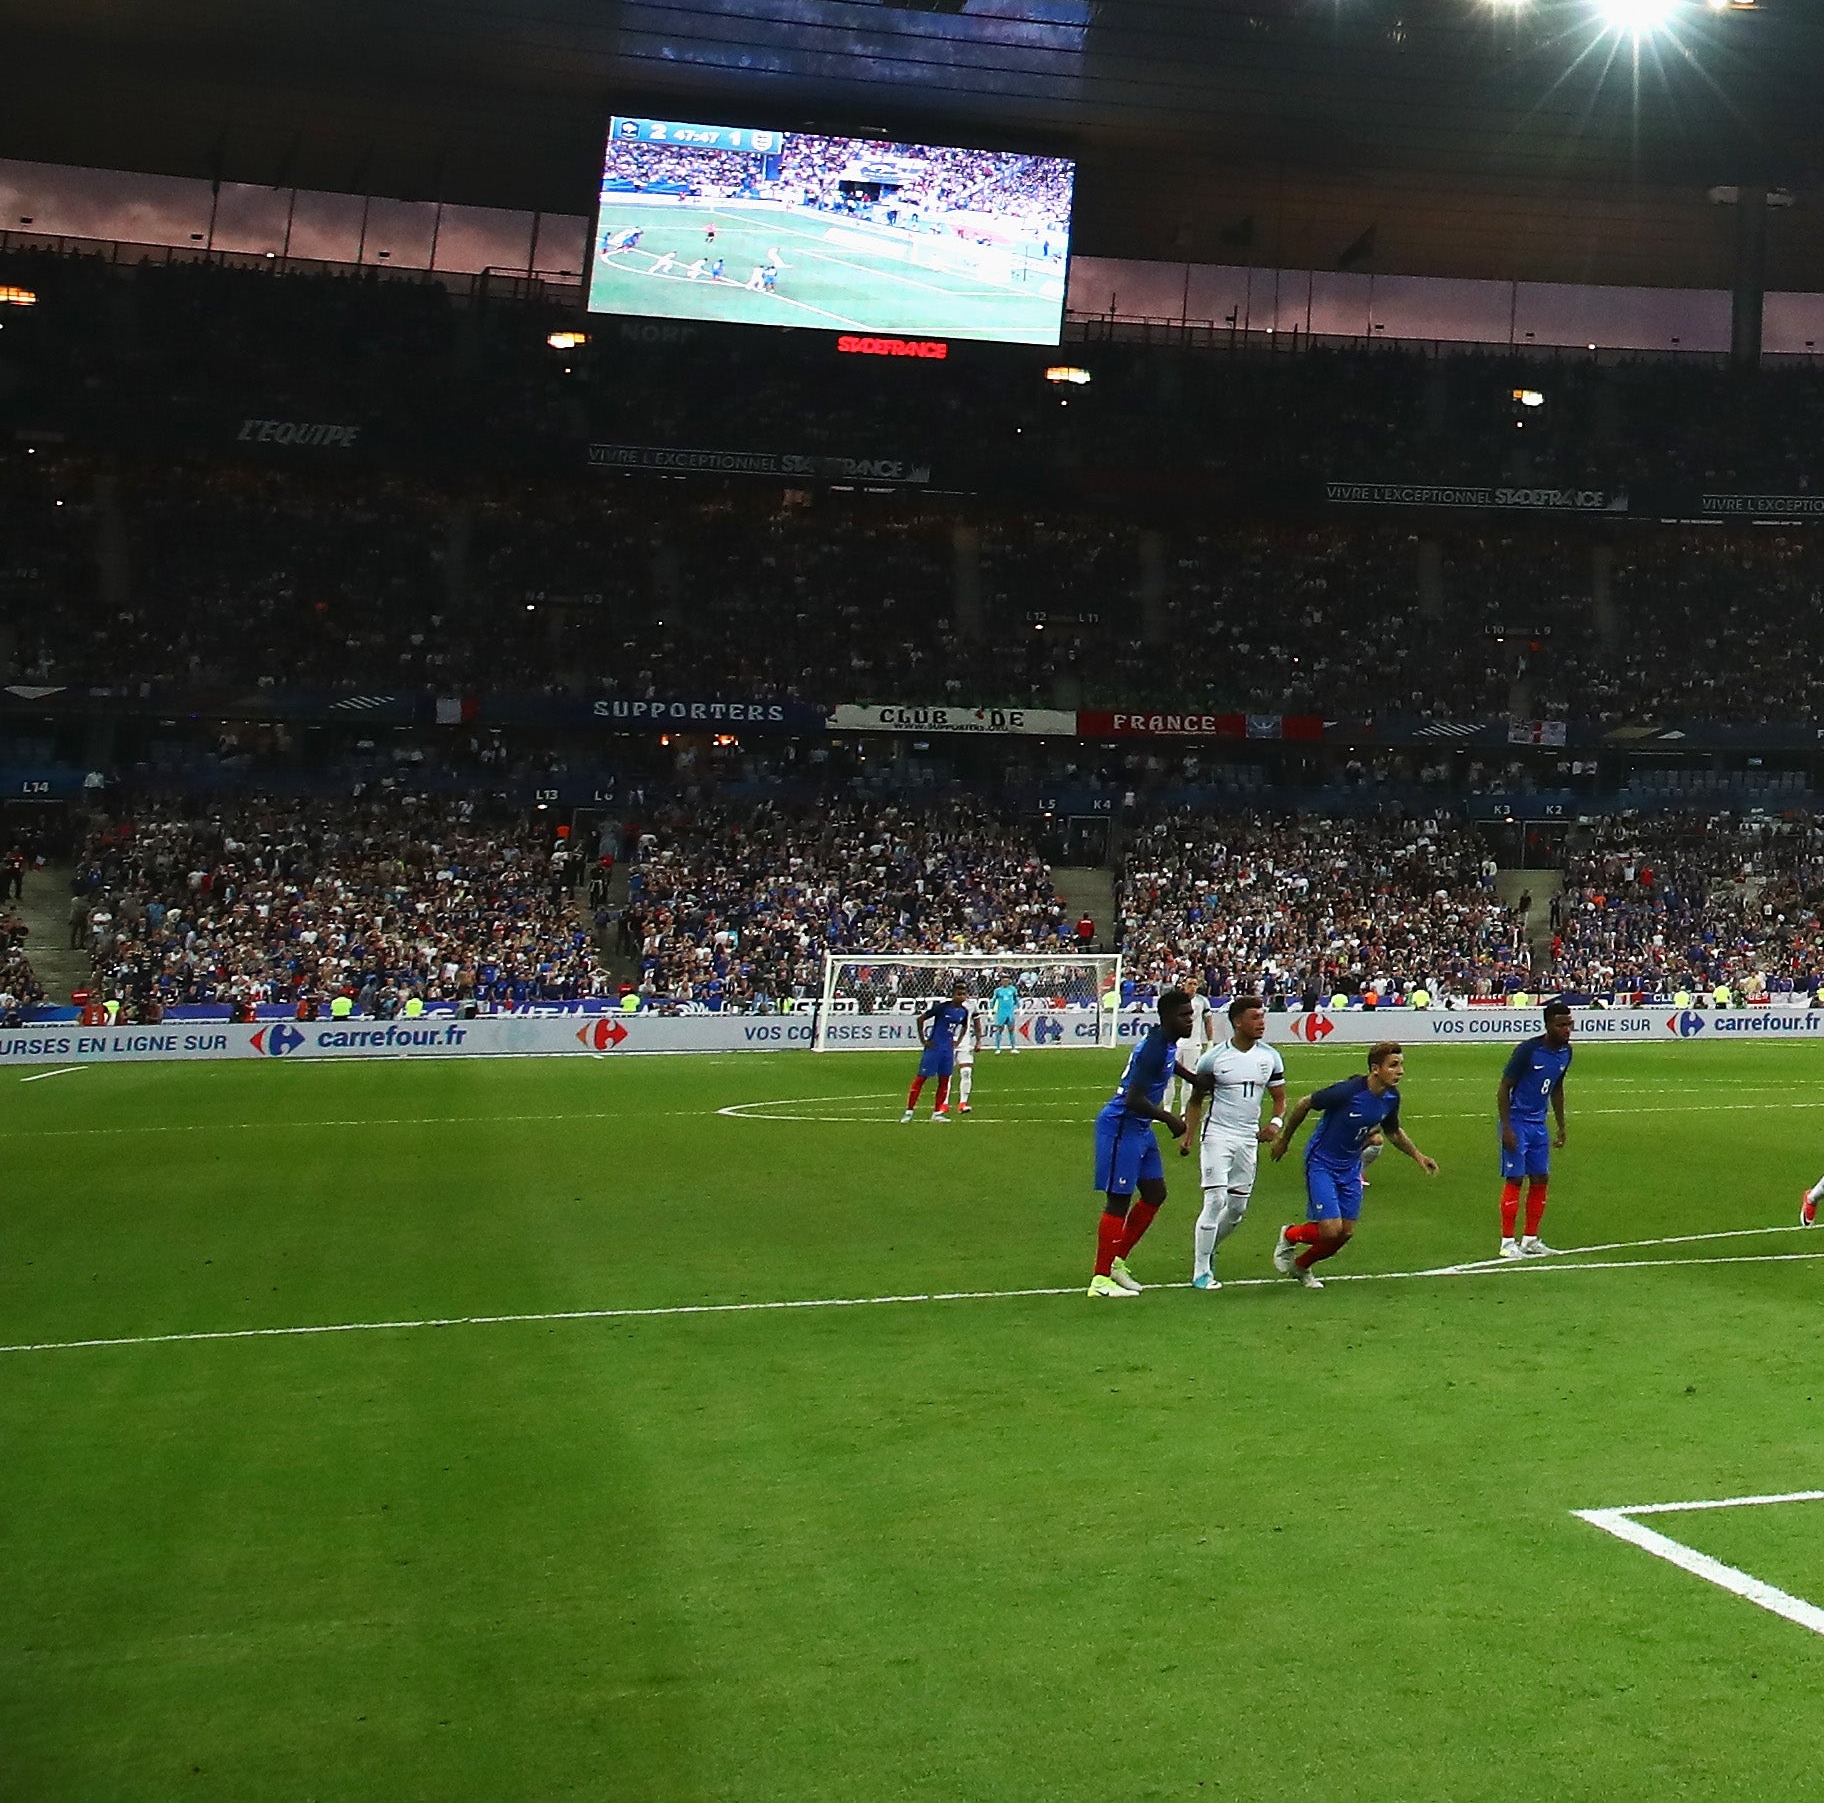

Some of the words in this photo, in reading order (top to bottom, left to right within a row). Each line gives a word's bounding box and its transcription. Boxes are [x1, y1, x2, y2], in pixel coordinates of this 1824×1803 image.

[650, 123, 667, 140] 2
[674, 128, 721, 144] 47:47
[729, 130, 742, 146] 1
[621, 322, 695, 344] NOR
[589, 446, 637, 464] VIVRE
[1327, 486, 1370, 500] VIVRE
[1373, 488, 1493, 504] L'EXCEPTIONNEL
[1702, 498, 1743, 512] VIVRE
[593, 700, 784, 722] SUPPORTERS
[879, 708, 949, 726] CLUB
[990, 711, 1025, 728] DE
[1113, 714, 1216, 733] FRANCE
[22, 781, 49, 794] L14
[536, 789, 559, 802] L13
[1093, 799, 1112, 811] K4
[1494, 804, 1512, 816] K3
[1545, 804, 1564, 816] K2
[1433, 1020, 1466, 1033] VOS
[1471, 1018, 1542, 1033] COURSES
[1619, 1018, 1650, 1032] SUR
[1714, 1009, 1820, 1033] carrefour.fr
[318, 1024, 467, 1049] carrefour.fr
[744, 1026, 781, 1041] VOS
[880, 1025, 901, 1039] EN
[0, 1040, 72, 1055] URSES
[78, 1038, 105, 1053] EN
[113, 1036, 178, 1051] LIGNE
[184, 1035, 227, 1050] SUR
[1241, 1082, 1256, 1097] 11
[1541, 1078, 1550, 1095] 8
